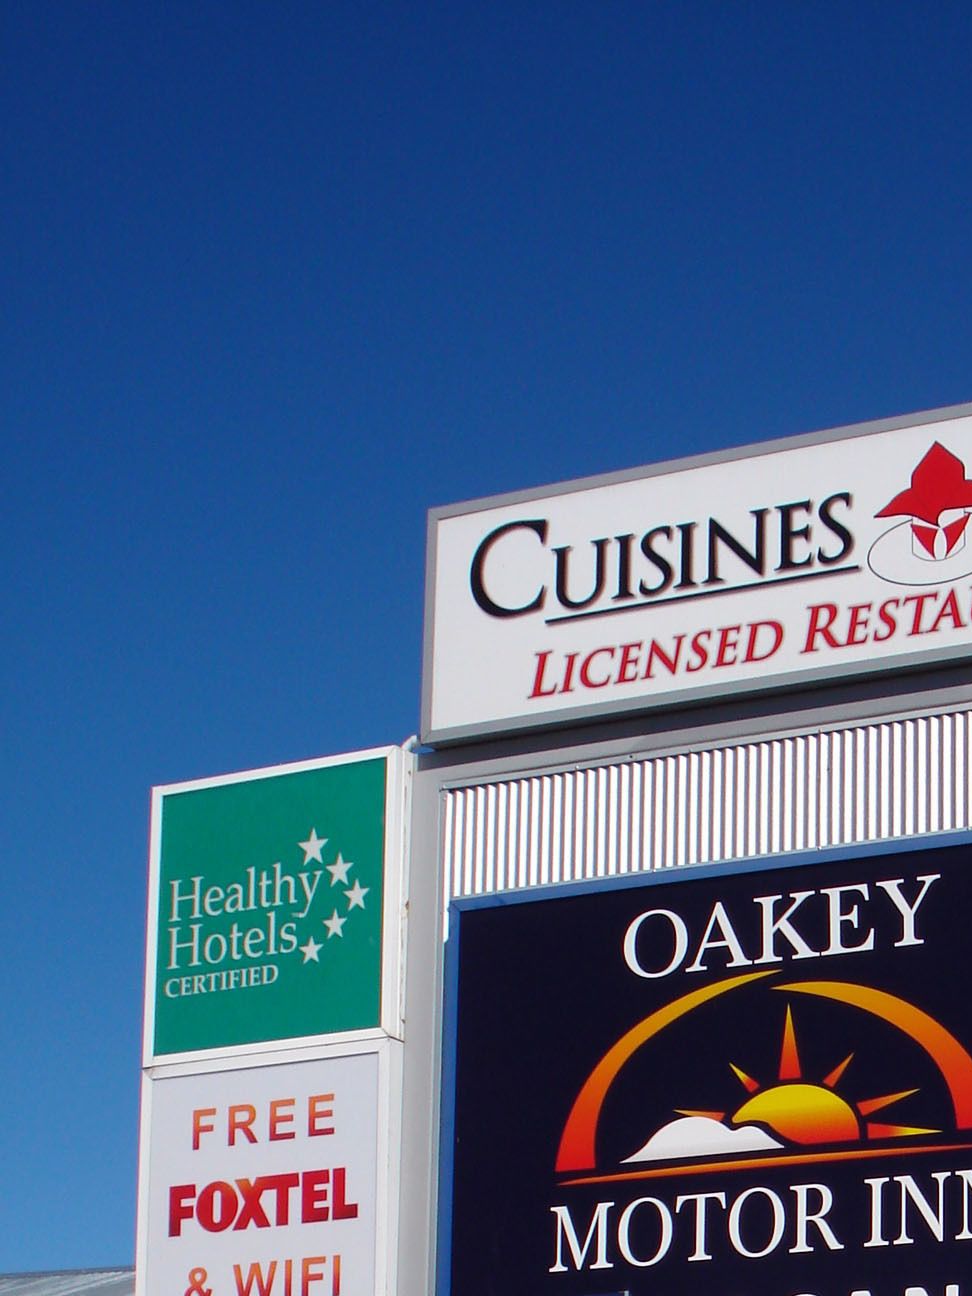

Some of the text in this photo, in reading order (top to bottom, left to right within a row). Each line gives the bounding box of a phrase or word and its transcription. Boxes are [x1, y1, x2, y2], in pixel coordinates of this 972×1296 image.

[470, 492, 855, 619] CUISINES
[527, 613, 783, 700] LICENSED
[168, 863, 323, 922] Healthy
[623, 874, 941, 978] OAKEY
[167, 912, 298, 969] Hotels
[164, 964, 279, 998] CERTIFIED
[192, 1093, 335, 1151] FREE
[168, 1167, 358, 1238] FOXTEL
[549, 1183, 844, 1273] MOTOR
